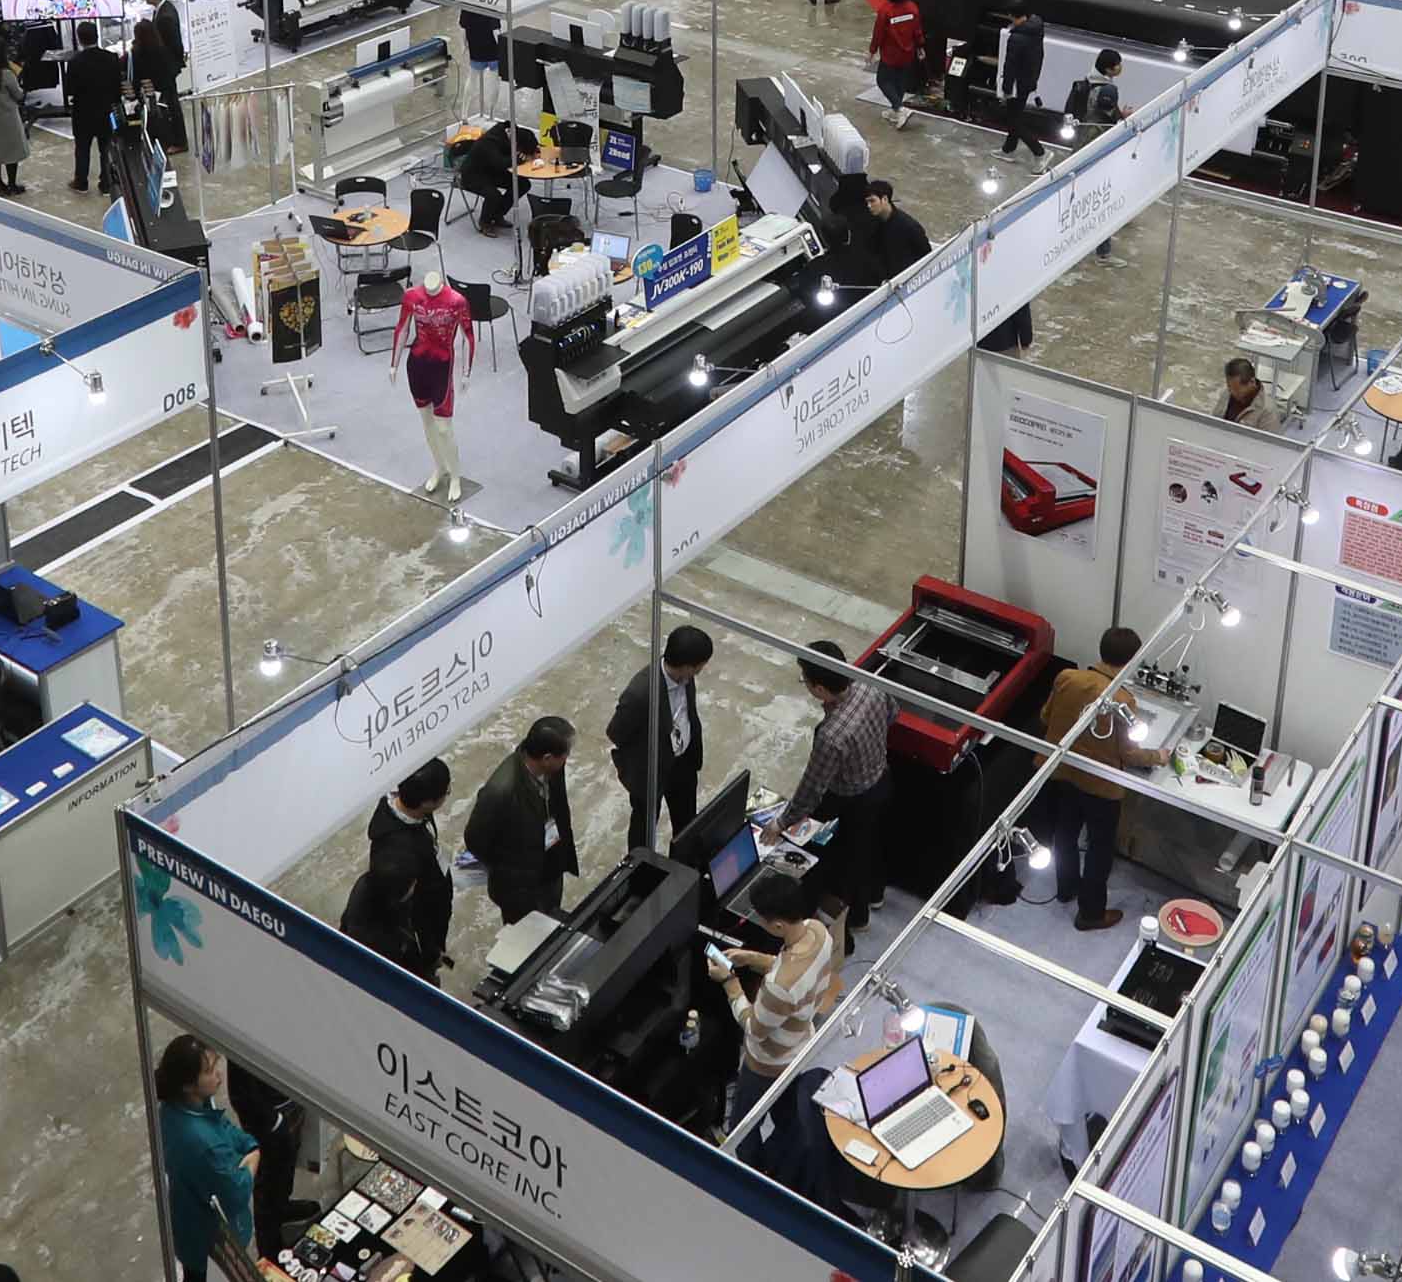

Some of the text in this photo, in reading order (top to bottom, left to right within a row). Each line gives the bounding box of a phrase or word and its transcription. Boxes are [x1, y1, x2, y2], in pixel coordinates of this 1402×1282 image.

[651, 259, 704, 301] JV300K-190
[161, 382, 197, 413] D08
[66, 758, 138, 813] INFORMATION
[136, 838, 287, 938] PREVIEW IN DAEGU
[376, 1042, 569, 1189] 이스트코아
[385, 1091, 564, 1220] EAST CORE INC.
